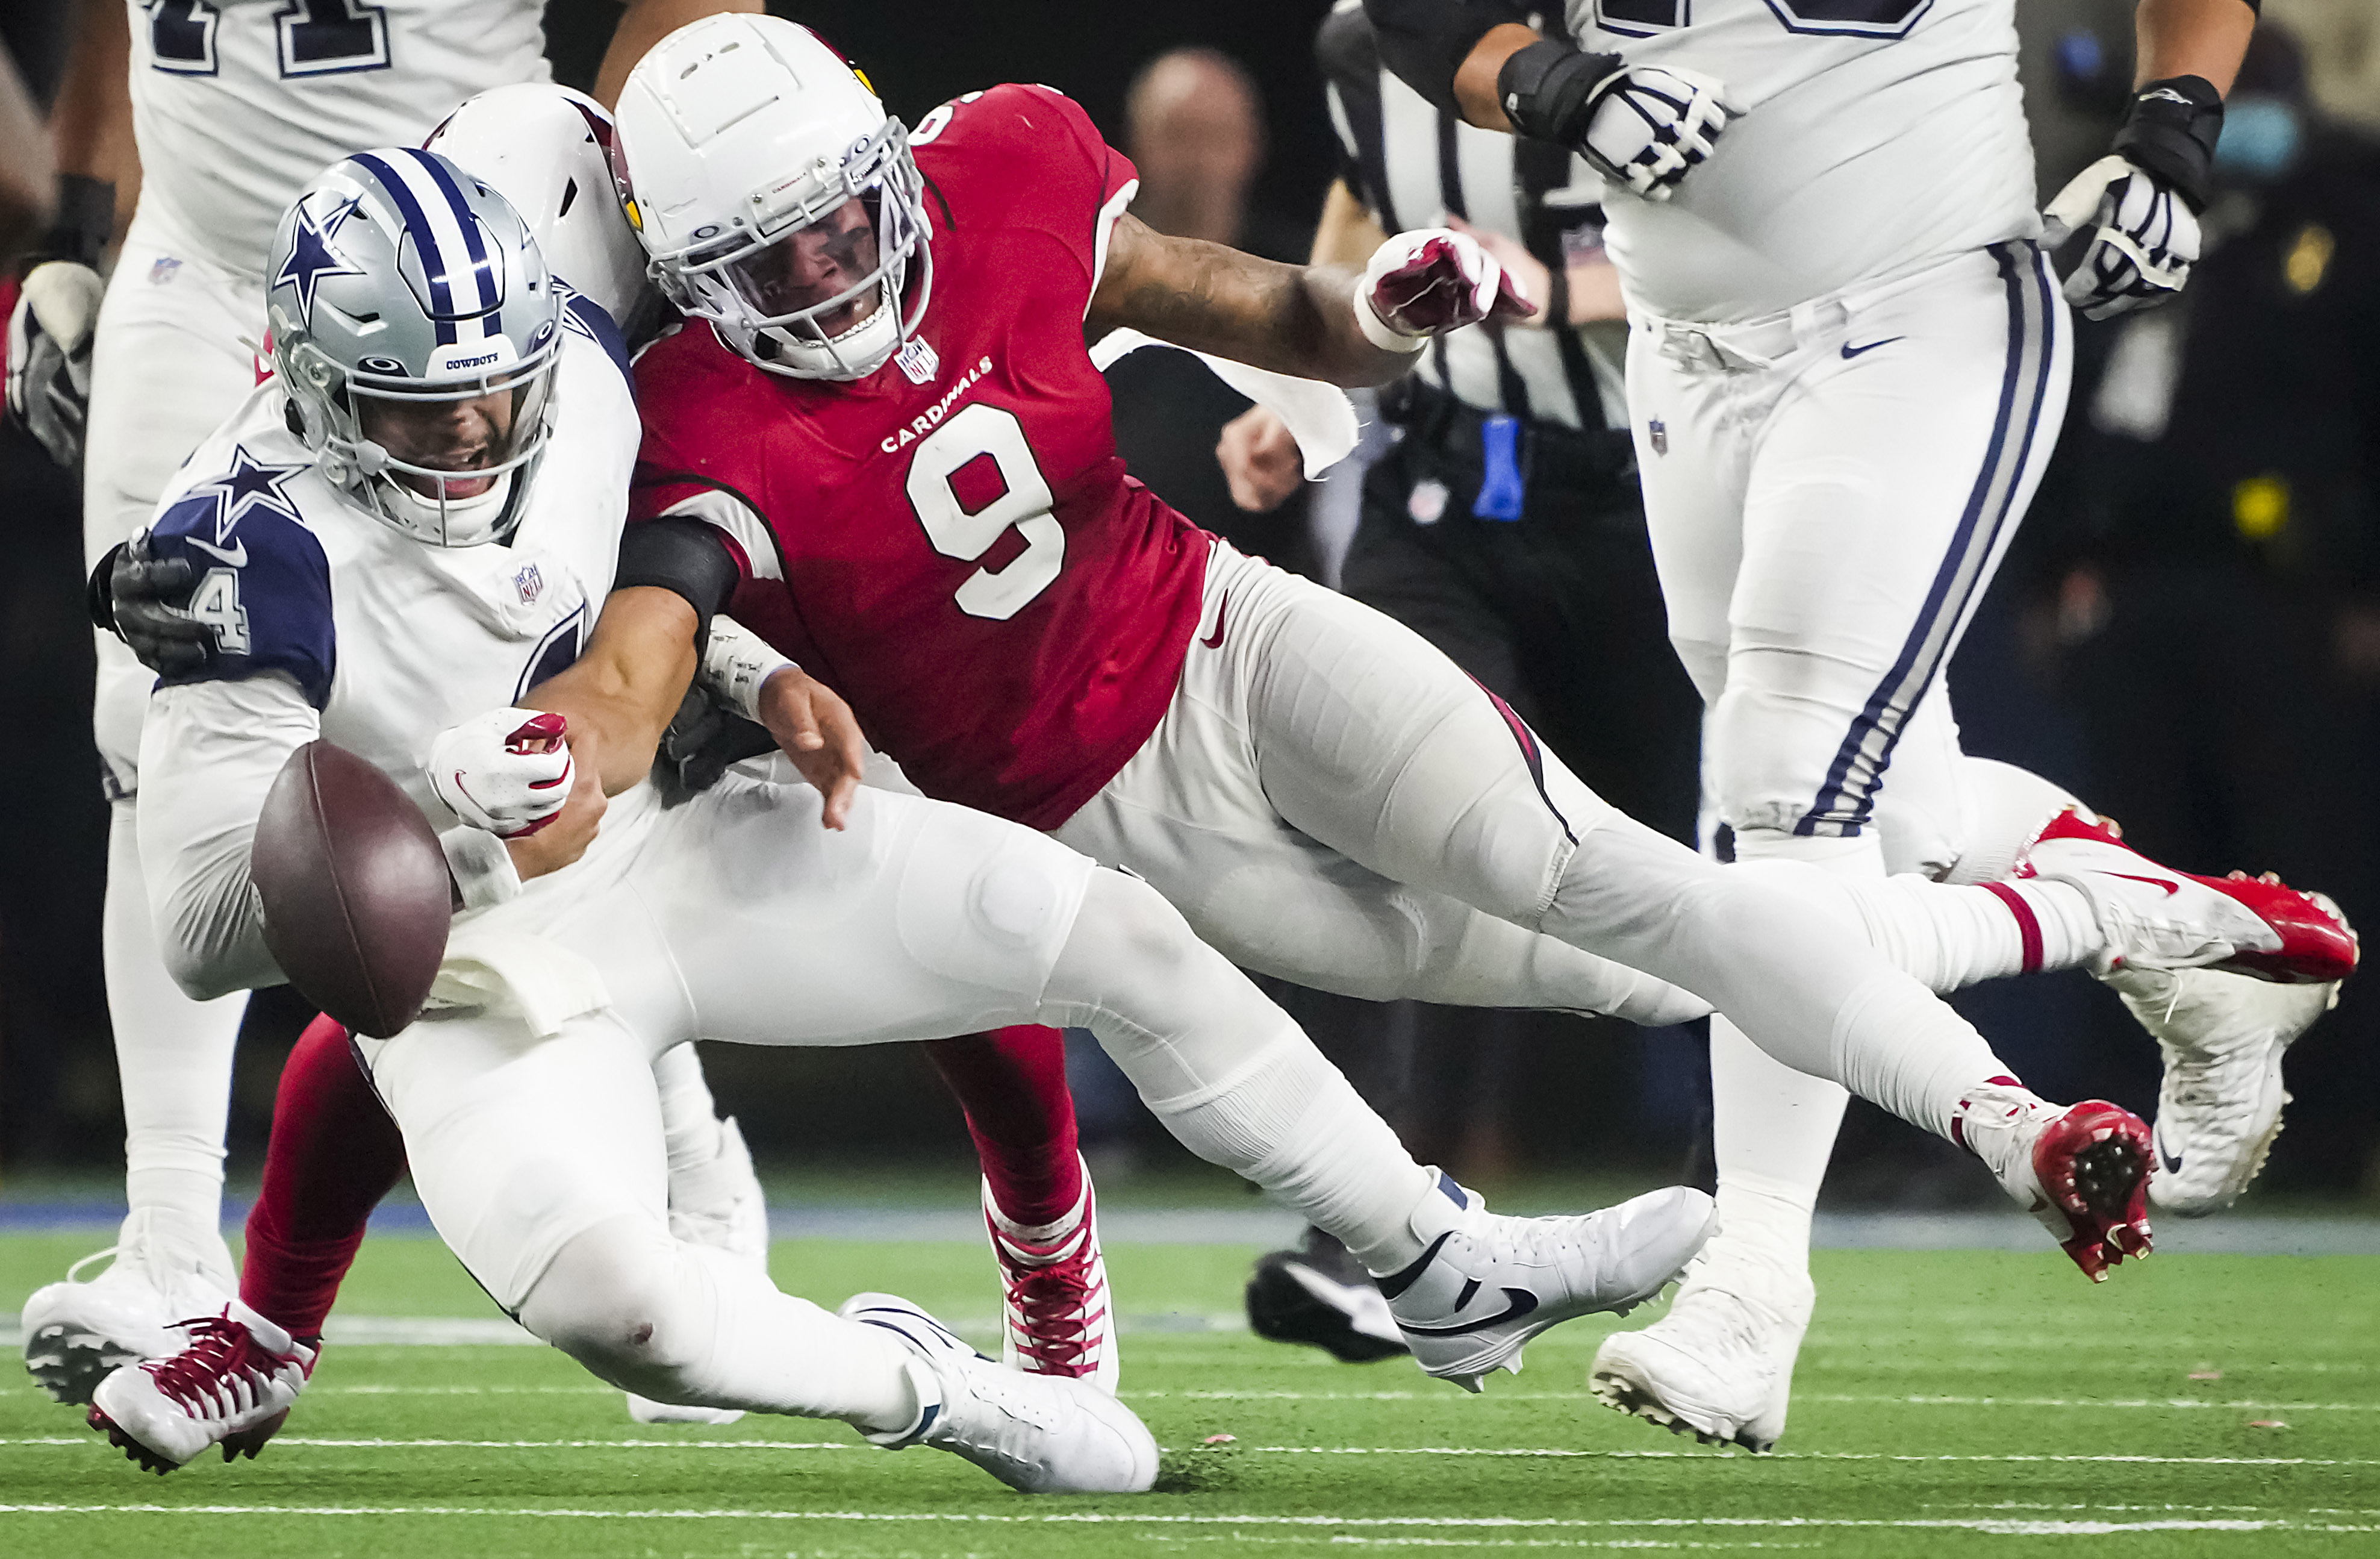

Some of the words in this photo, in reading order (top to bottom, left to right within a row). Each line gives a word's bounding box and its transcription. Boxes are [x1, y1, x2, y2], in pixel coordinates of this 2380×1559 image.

[446, 352, 498, 370] COWBOYS
[880, 355, 993, 453] CARDINALS
[906, 401, 1065, 621] 9
[188, 567, 252, 655] 4
